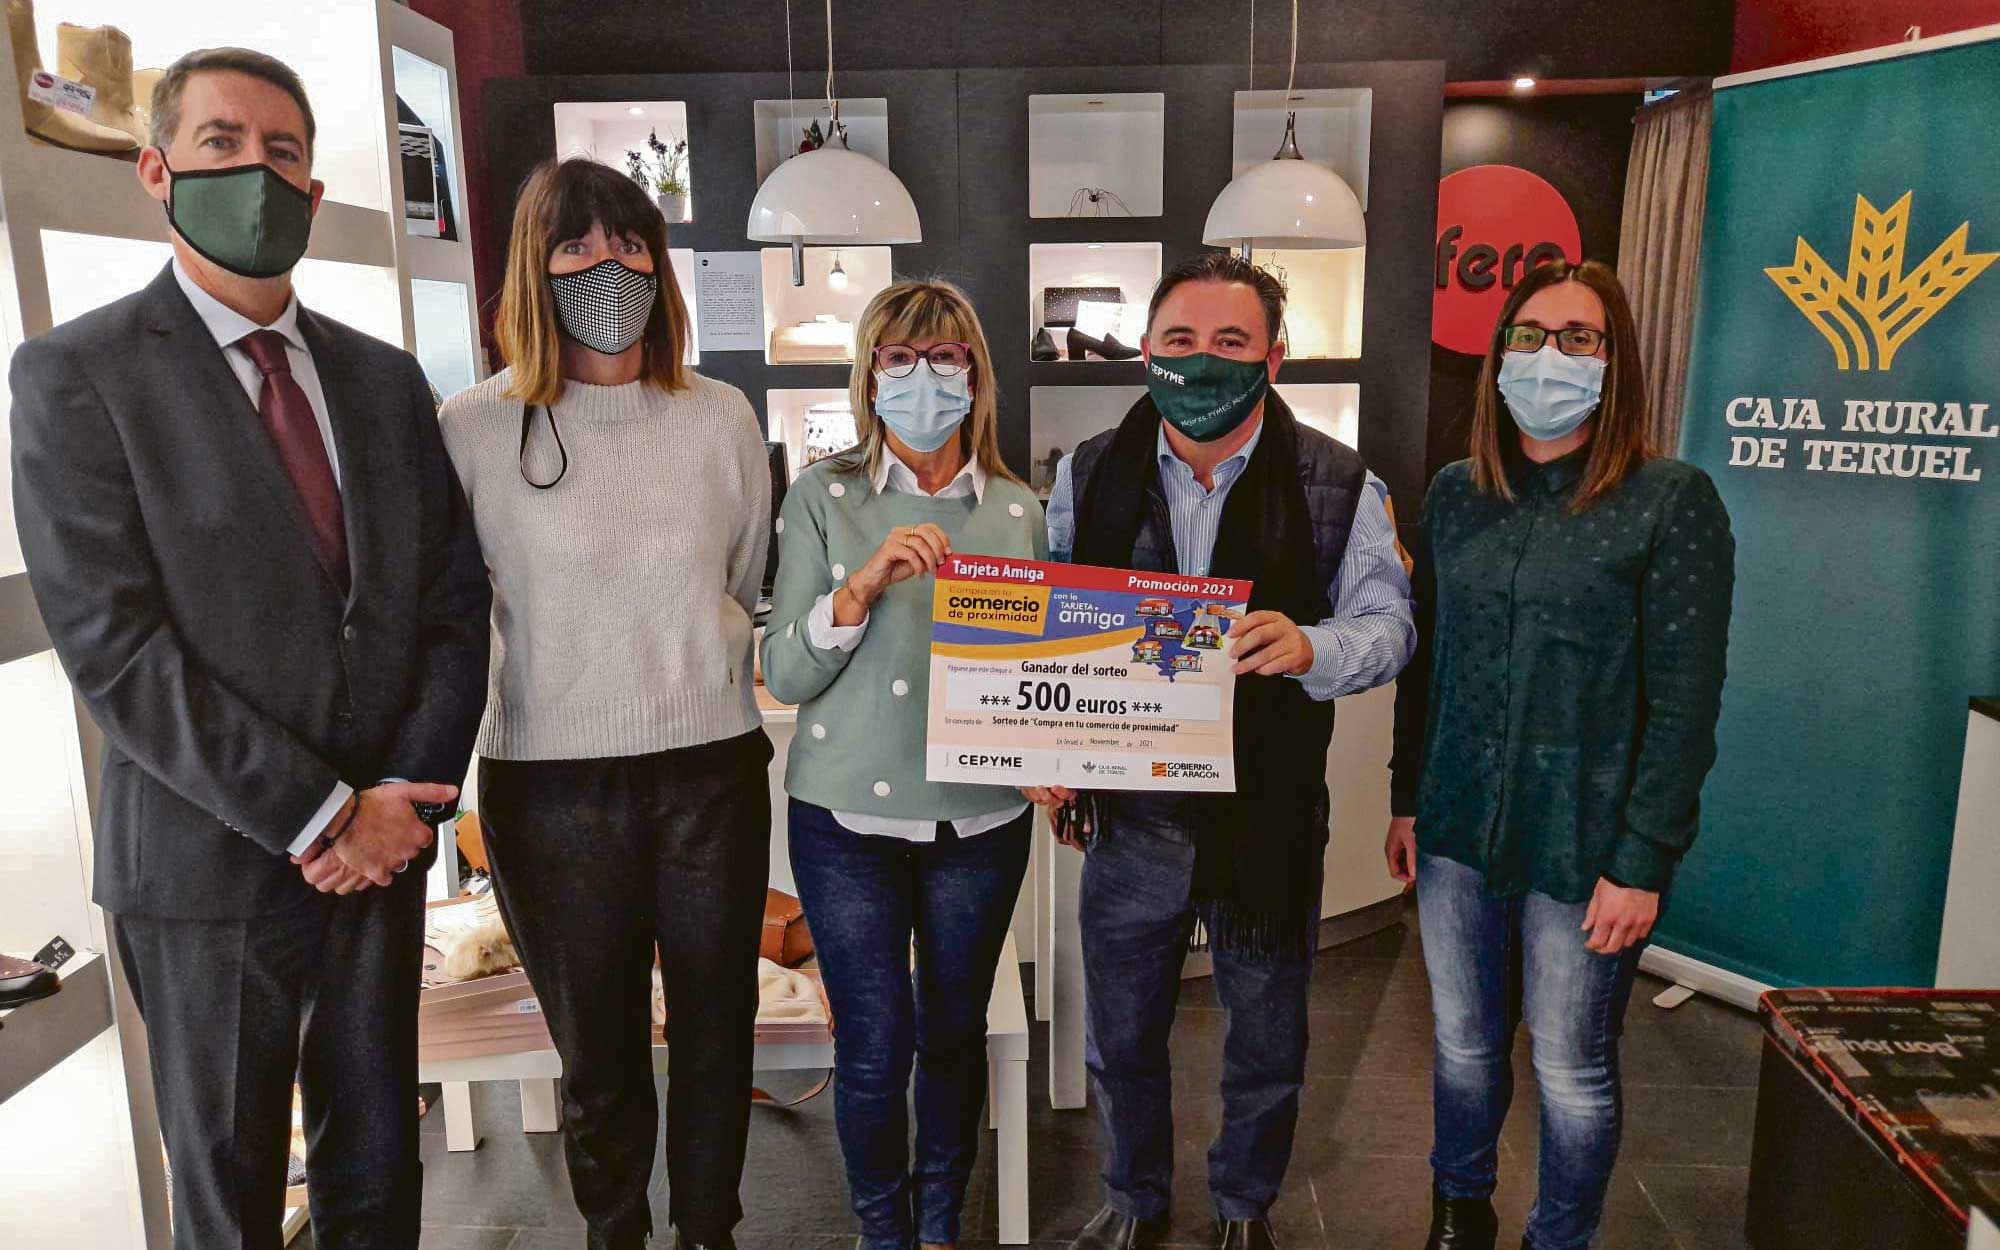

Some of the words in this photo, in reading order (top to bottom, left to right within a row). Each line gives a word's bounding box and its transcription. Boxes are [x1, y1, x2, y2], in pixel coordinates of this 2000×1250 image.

[1151, 362, 1184, 385] CEPYME
[1726, 397, 1825, 430] CAJA
[1841, 400, 1999, 437] RURAL
[1729, 436, 1787, 468] DE
[1804, 439, 1981, 481] TERUEL
[953, 560, 999, 578] Tarjeta
[1002, 564, 1044, 582] Amiga
[949, 586, 987, 596] Compra
[1128, 576, 1198, 593] Promoción
[1202, 583, 1234, 596] 2021
[949, 596, 1039, 612] comercio
[1070, 592, 1078, 601] la
[1060, 602, 1093, 610] TARJETA
[948, 609, 963, 618] de
[967, 611, 1037, 622] proximidad
[1059, 608, 1125, 629] amiga
[1021, 661, 1068, 674] Ganador
[1072, 663, 1088, 675] del
[1093, 667, 1127, 677] sorteo
[1017, 681, 1070, 712] 500
[1076, 698, 1126, 714] euros
[992, 716, 1018, 725] Sorteo
[1020, 717, 1029, 726] de
[1076, 720, 1084, 728] tu
[1086, 721, 1119, 729] comercio
[1121, 722, 1130, 730] de
[1089, 737, 1119, 746] Noviembre
[958, 754, 1022, 767] CEPYME
[1167, 763, 1213, 771] GOBIERNO
